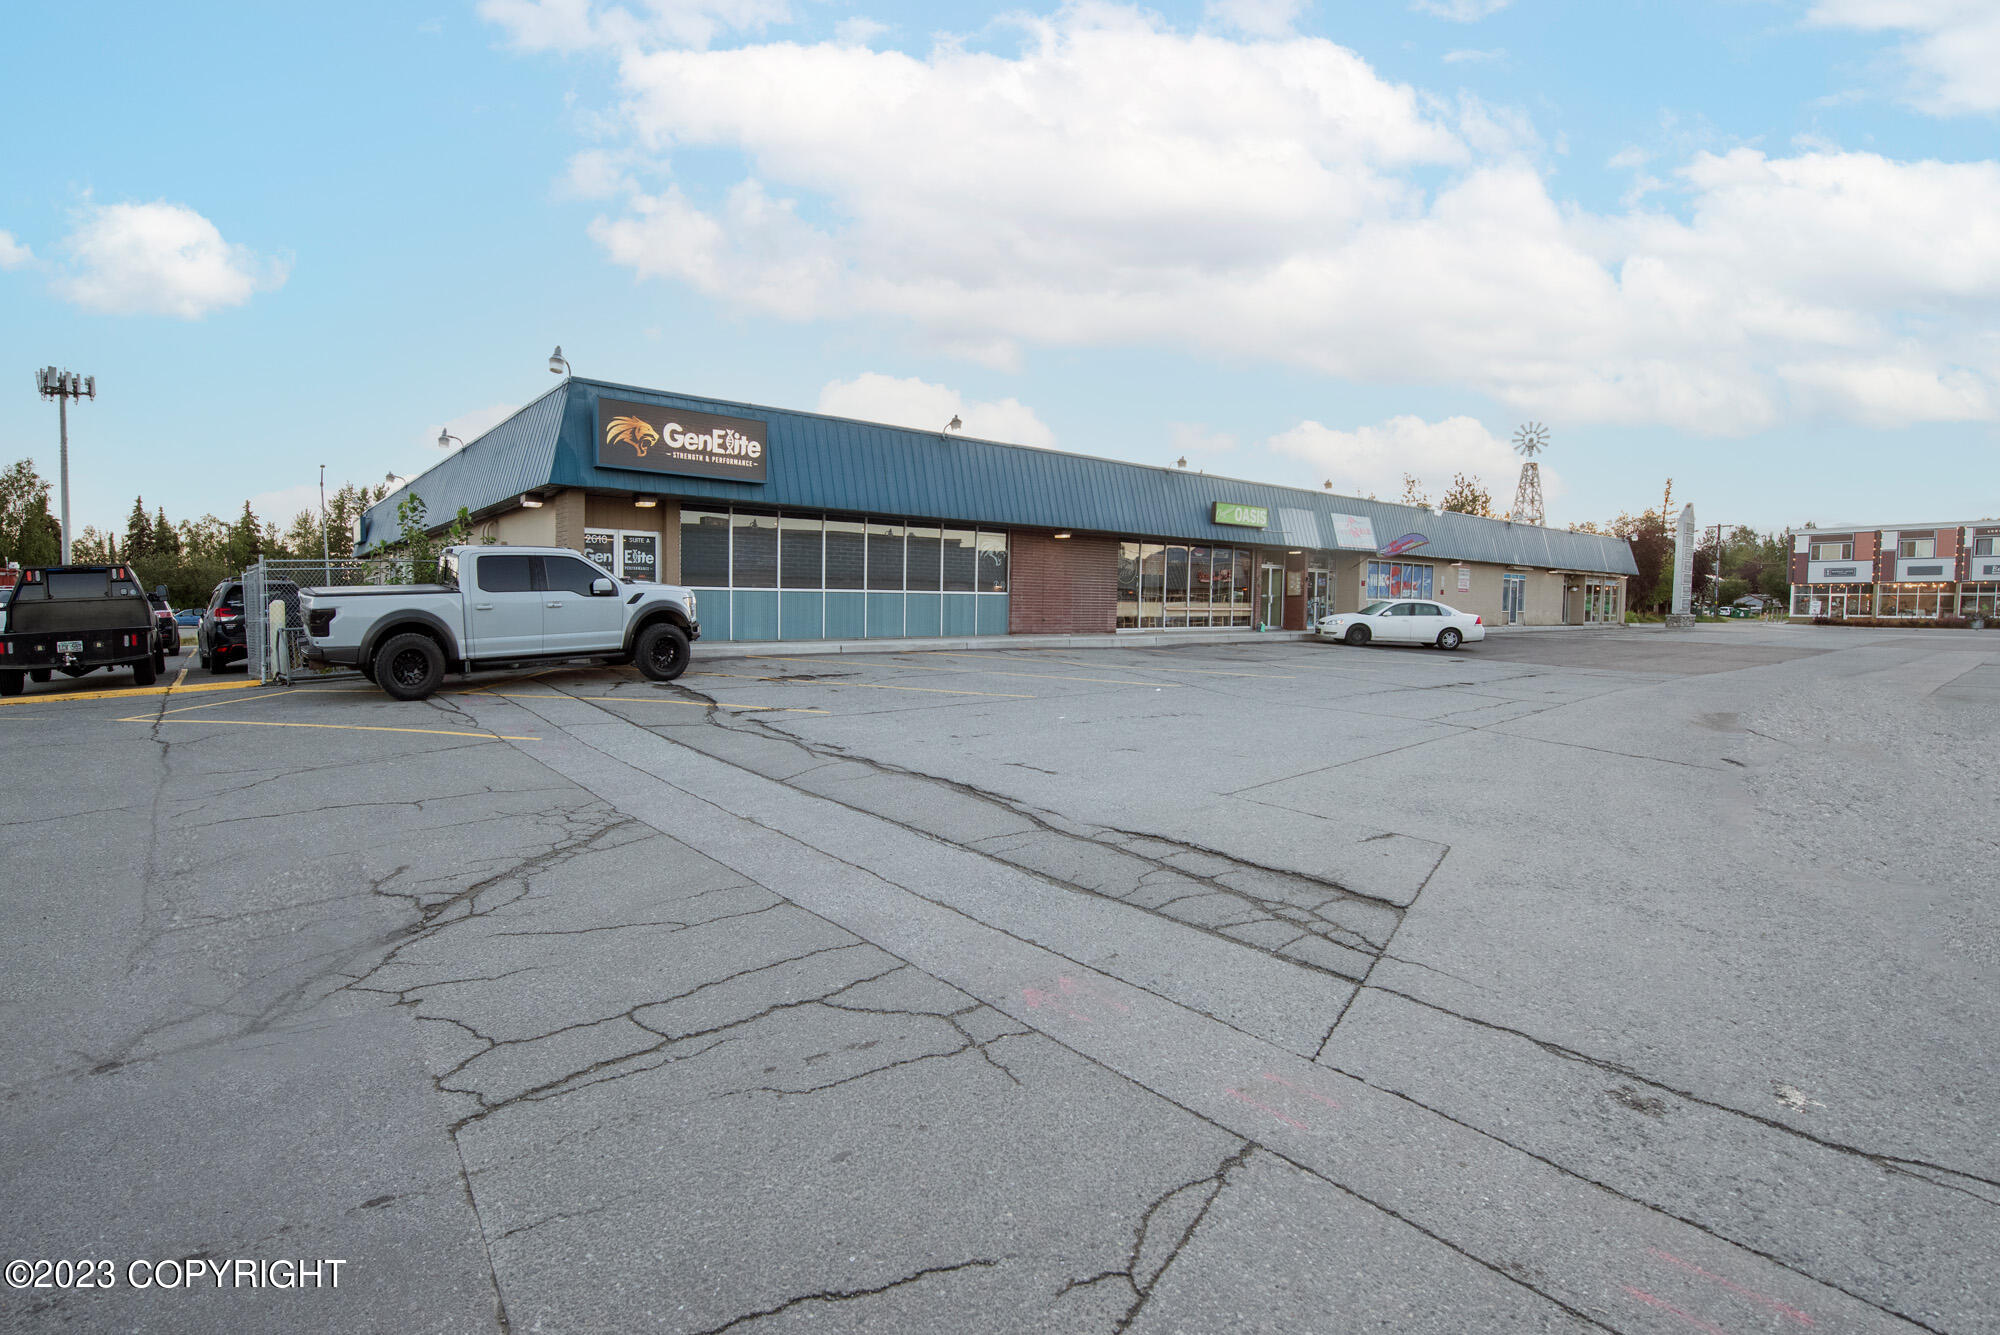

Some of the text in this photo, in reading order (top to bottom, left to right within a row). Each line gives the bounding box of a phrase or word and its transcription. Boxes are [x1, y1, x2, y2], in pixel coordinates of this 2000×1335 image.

[672, 452, 753, 468] STRENGTH & PERFORMANCE
[1234, 507, 1267, 525] OASIS
